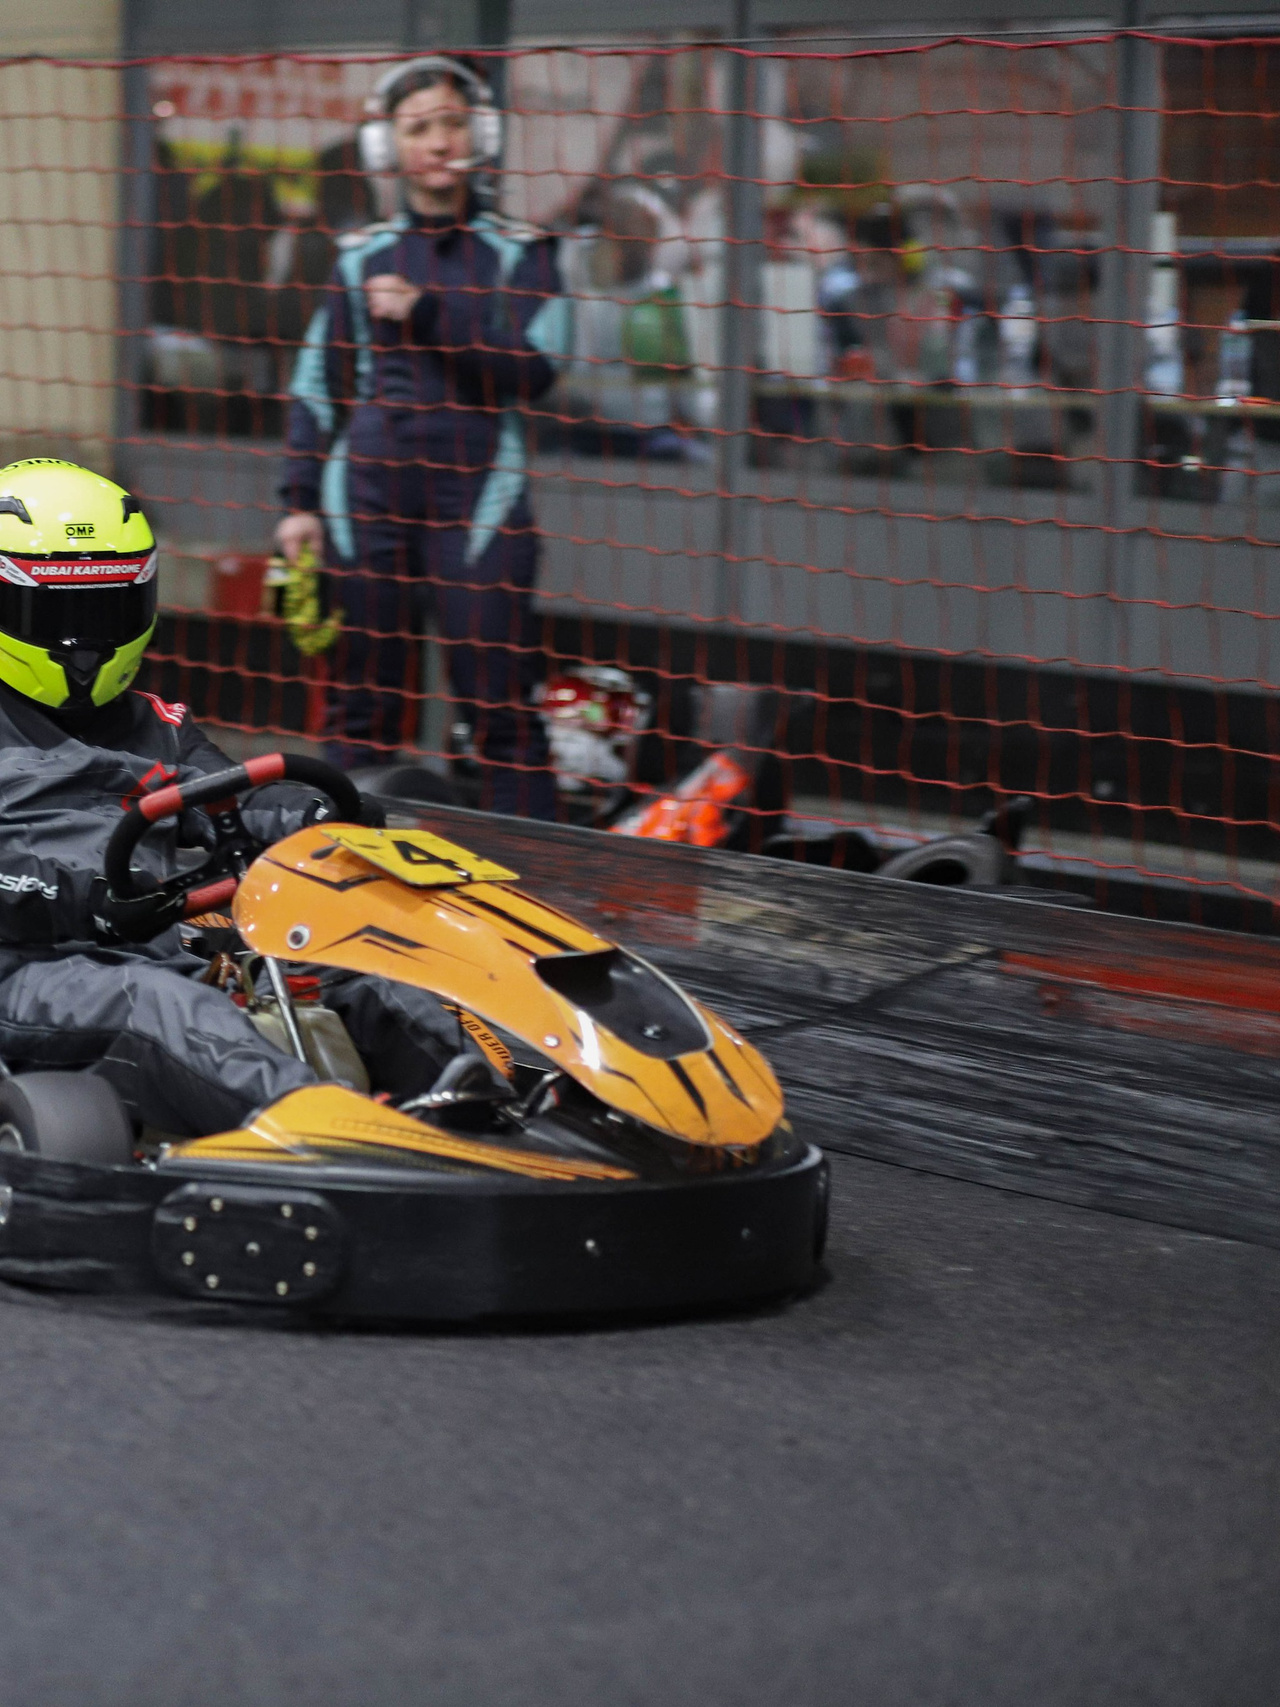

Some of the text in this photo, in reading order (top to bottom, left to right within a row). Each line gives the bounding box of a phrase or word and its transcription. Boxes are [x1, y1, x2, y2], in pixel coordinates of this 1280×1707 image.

[65, 525, 95, 537] OMP
[31, 566, 72, 576] DUBAI
[73, 564, 142, 575] KARTDROME
[391, 840, 470, 879] 4
